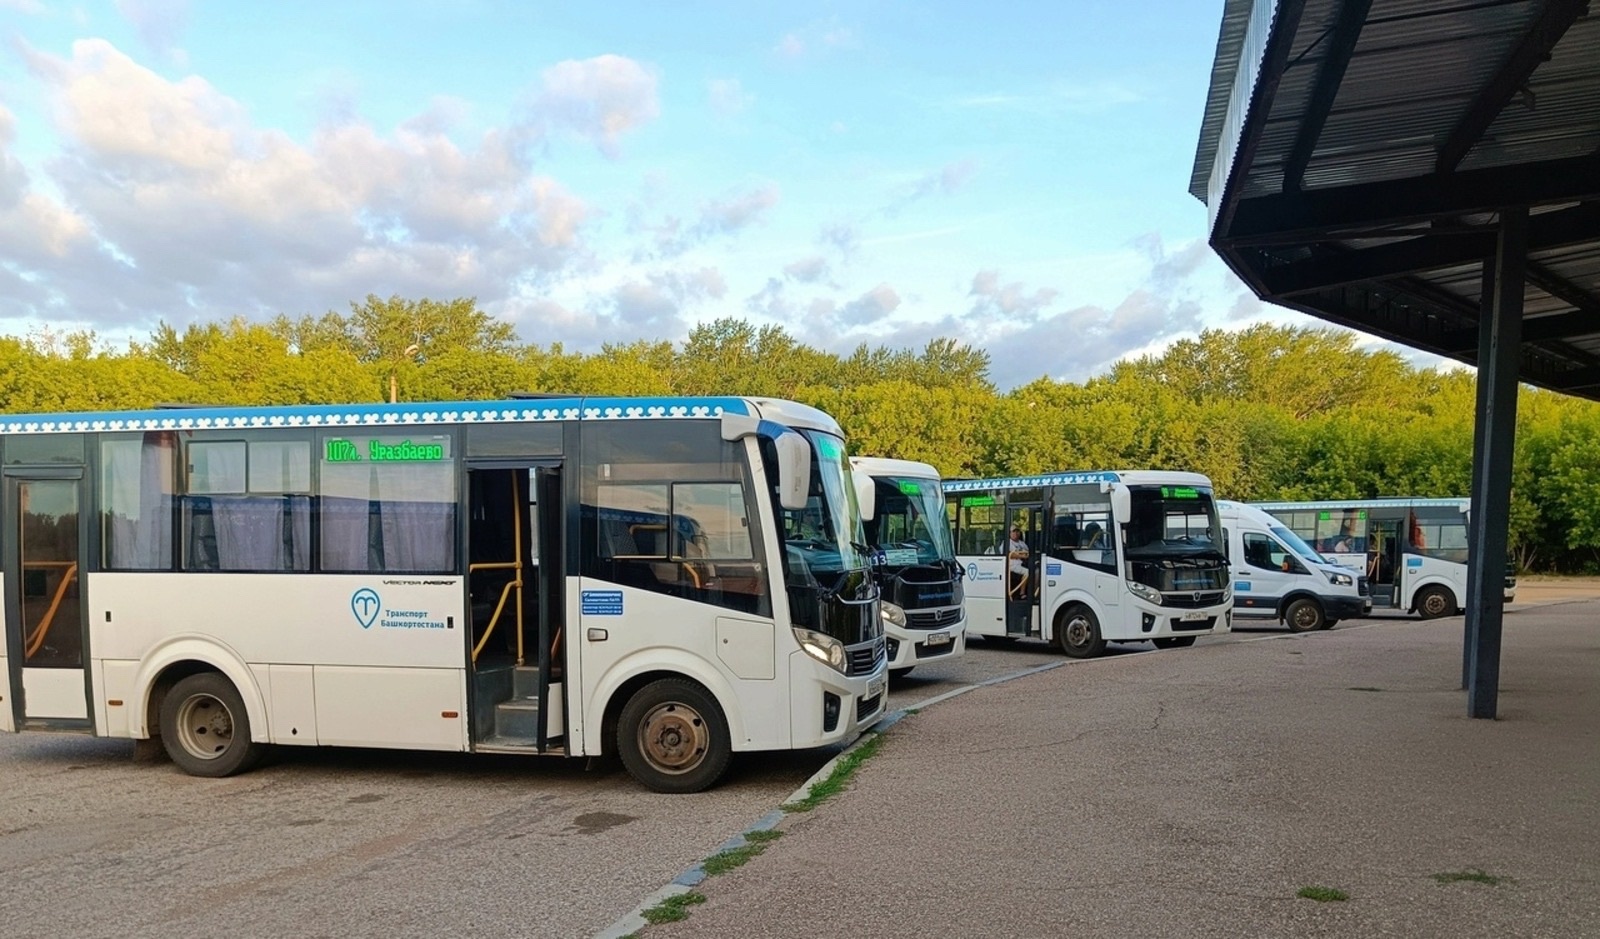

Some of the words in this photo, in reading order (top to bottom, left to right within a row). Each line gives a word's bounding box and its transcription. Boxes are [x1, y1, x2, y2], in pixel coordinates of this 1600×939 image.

[370, 439, 442, 461] Уразбаево
[385, 609, 428, 619] Транспорт
[380, 619, 445, 630] Башкортостана
